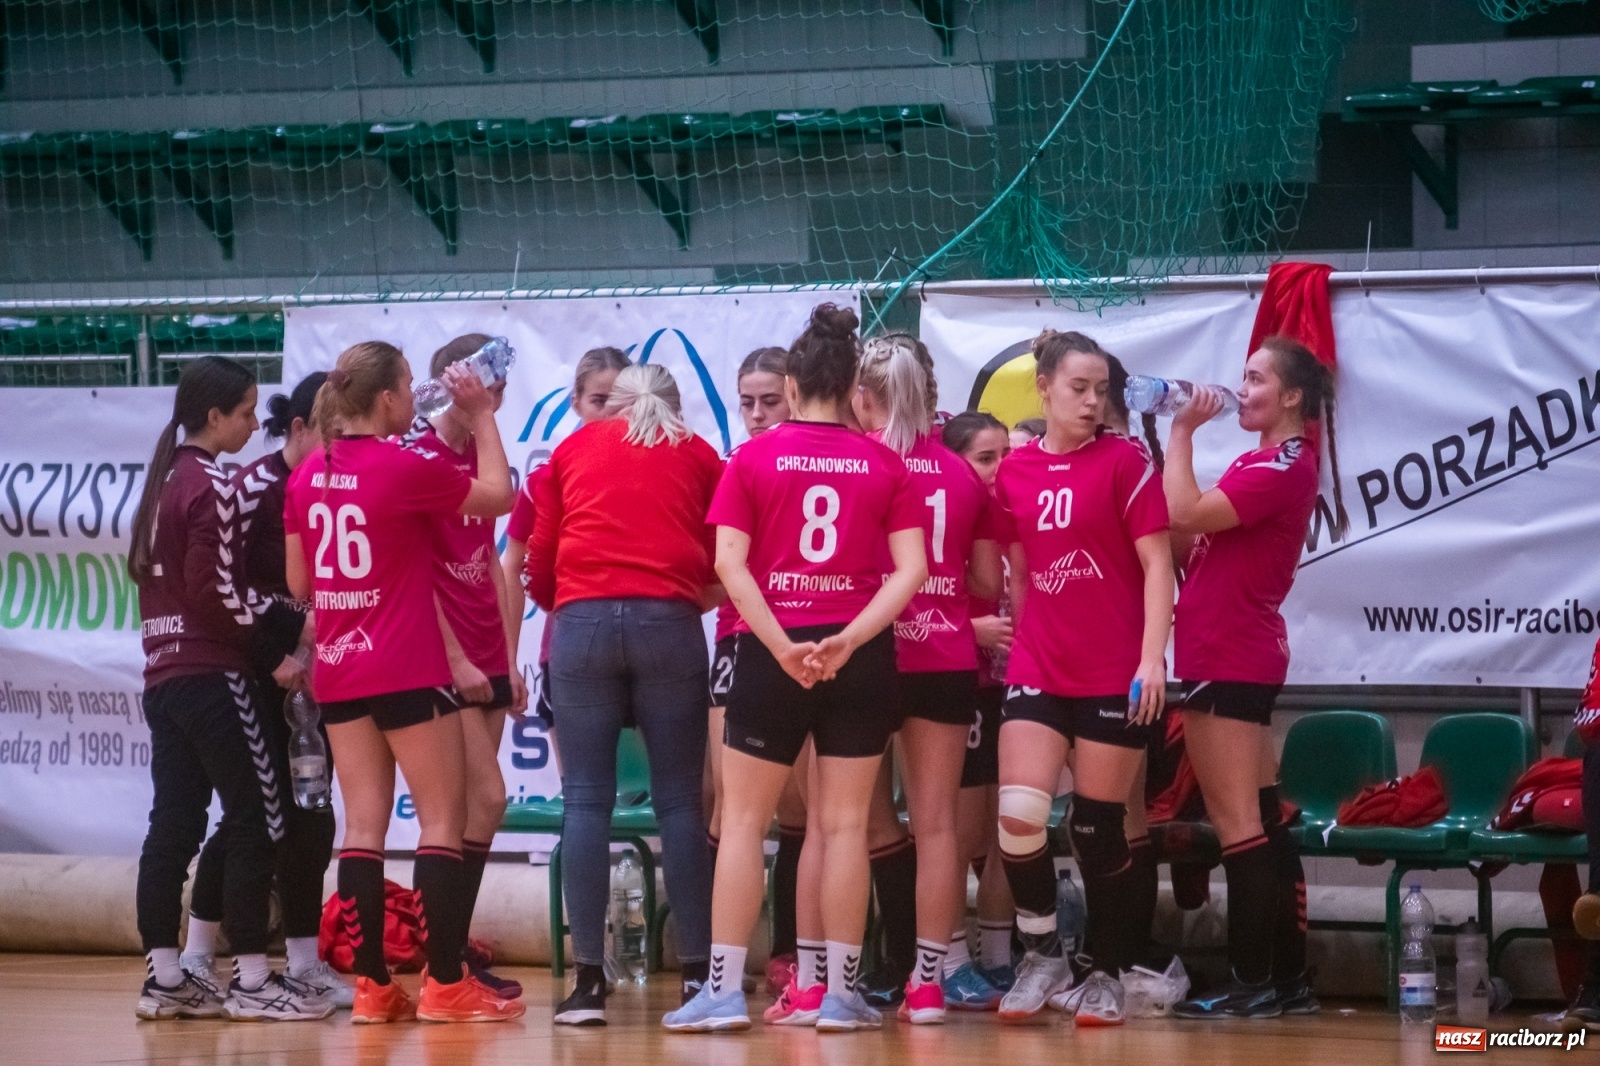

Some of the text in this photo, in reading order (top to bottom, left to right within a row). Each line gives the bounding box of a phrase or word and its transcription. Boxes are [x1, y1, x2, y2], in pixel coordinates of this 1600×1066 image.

[310, 472, 358, 490] KOALSKA
[776, 455, 869, 475] CHRZANOWSKA
[799, 484, 840, 563] 8
[925, 488, 946, 563] 1
[1037, 487, 1073, 531] 20
[308, 502, 373, 579] 26
[0, 551, 142, 632] OMOW
[768, 571, 855, 592] PIETROWICE
[1363, 598, 1600, 634] www.osir-racib
[47, 682, 74, 724] się
[77, 690, 132, 725] naszą
[0, 731, 42, 774] edzą
[48, 731, 70, 766] od
[78, 731, 124, 767] 1989
